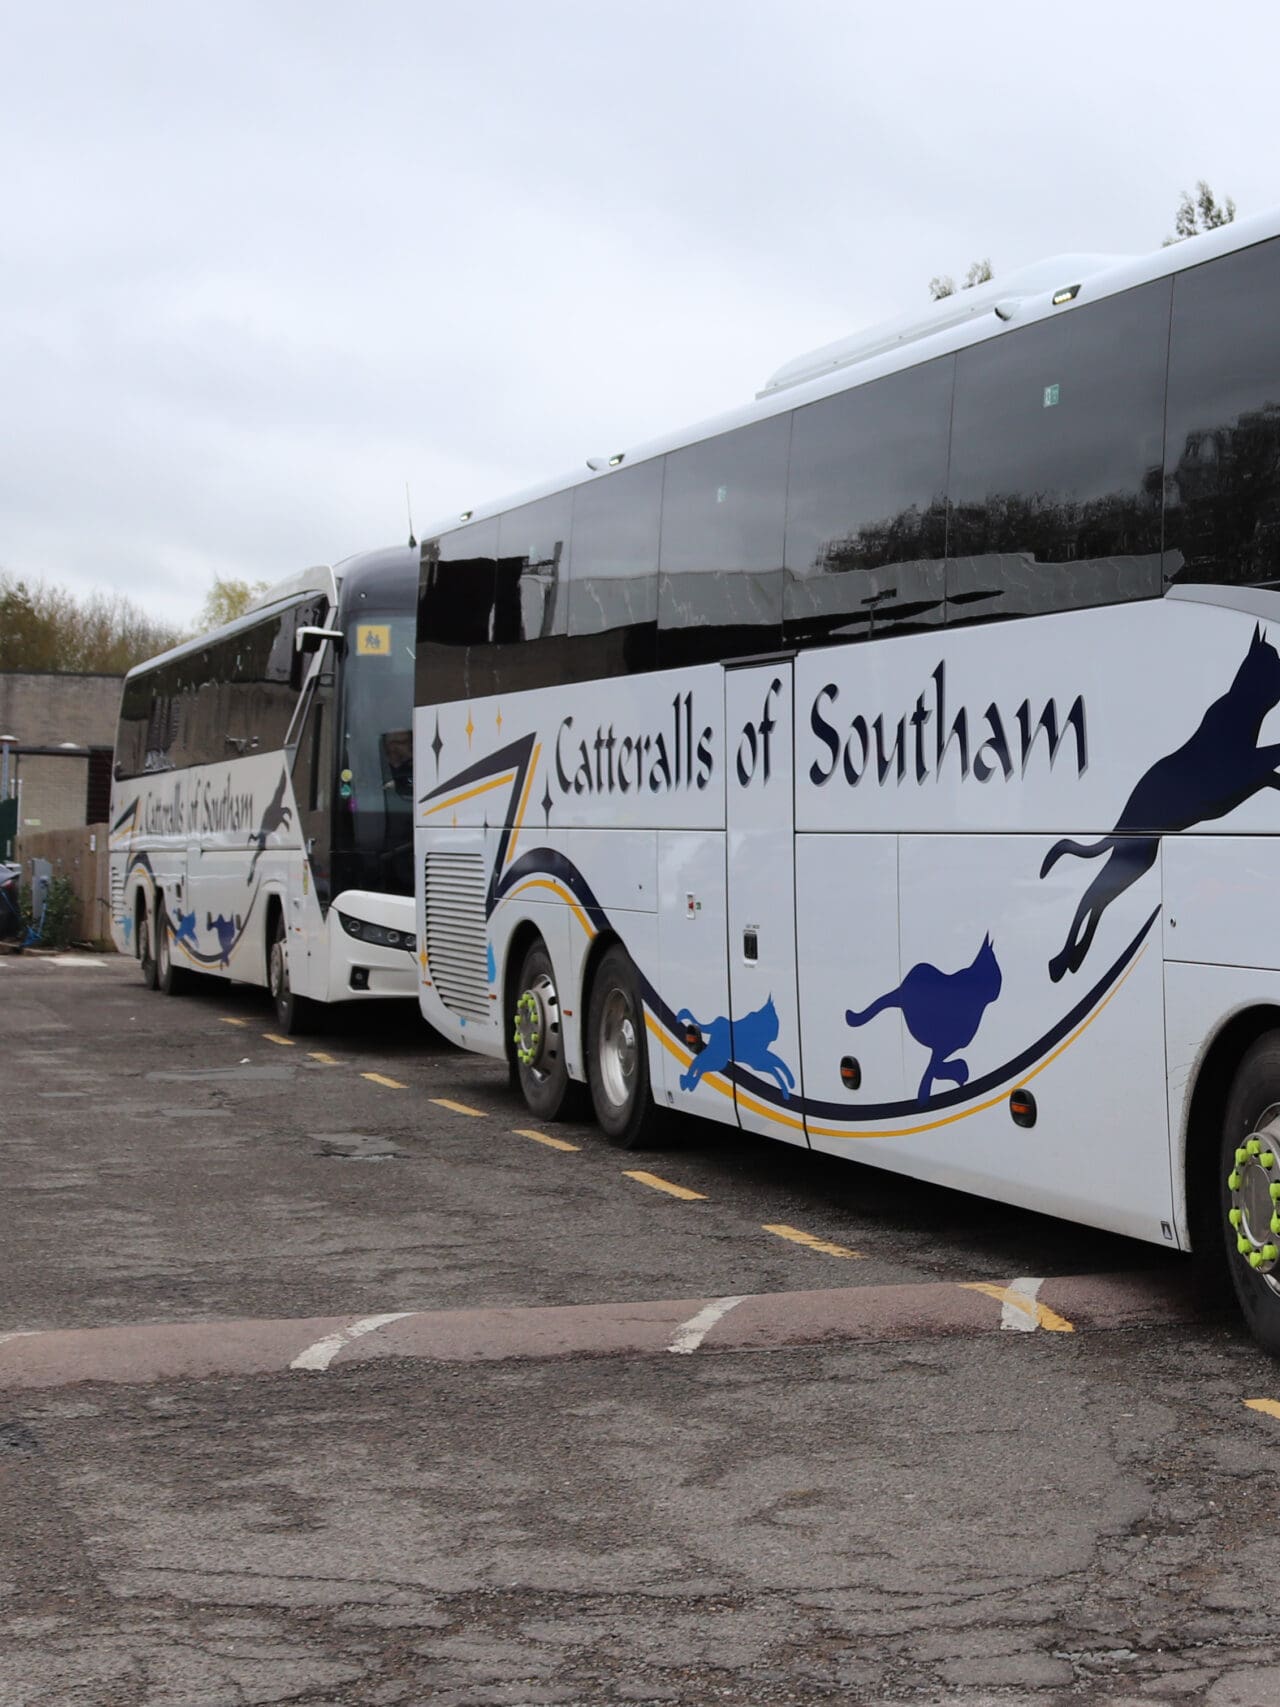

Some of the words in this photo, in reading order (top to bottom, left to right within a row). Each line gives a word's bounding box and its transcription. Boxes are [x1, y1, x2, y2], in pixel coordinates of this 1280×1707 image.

[555, 690, 714, 796] Catteralls
[736, 677, 783, 789] of
[808, 659, 1088, 788] Southam
[203, 773, 253, 832] Southam
